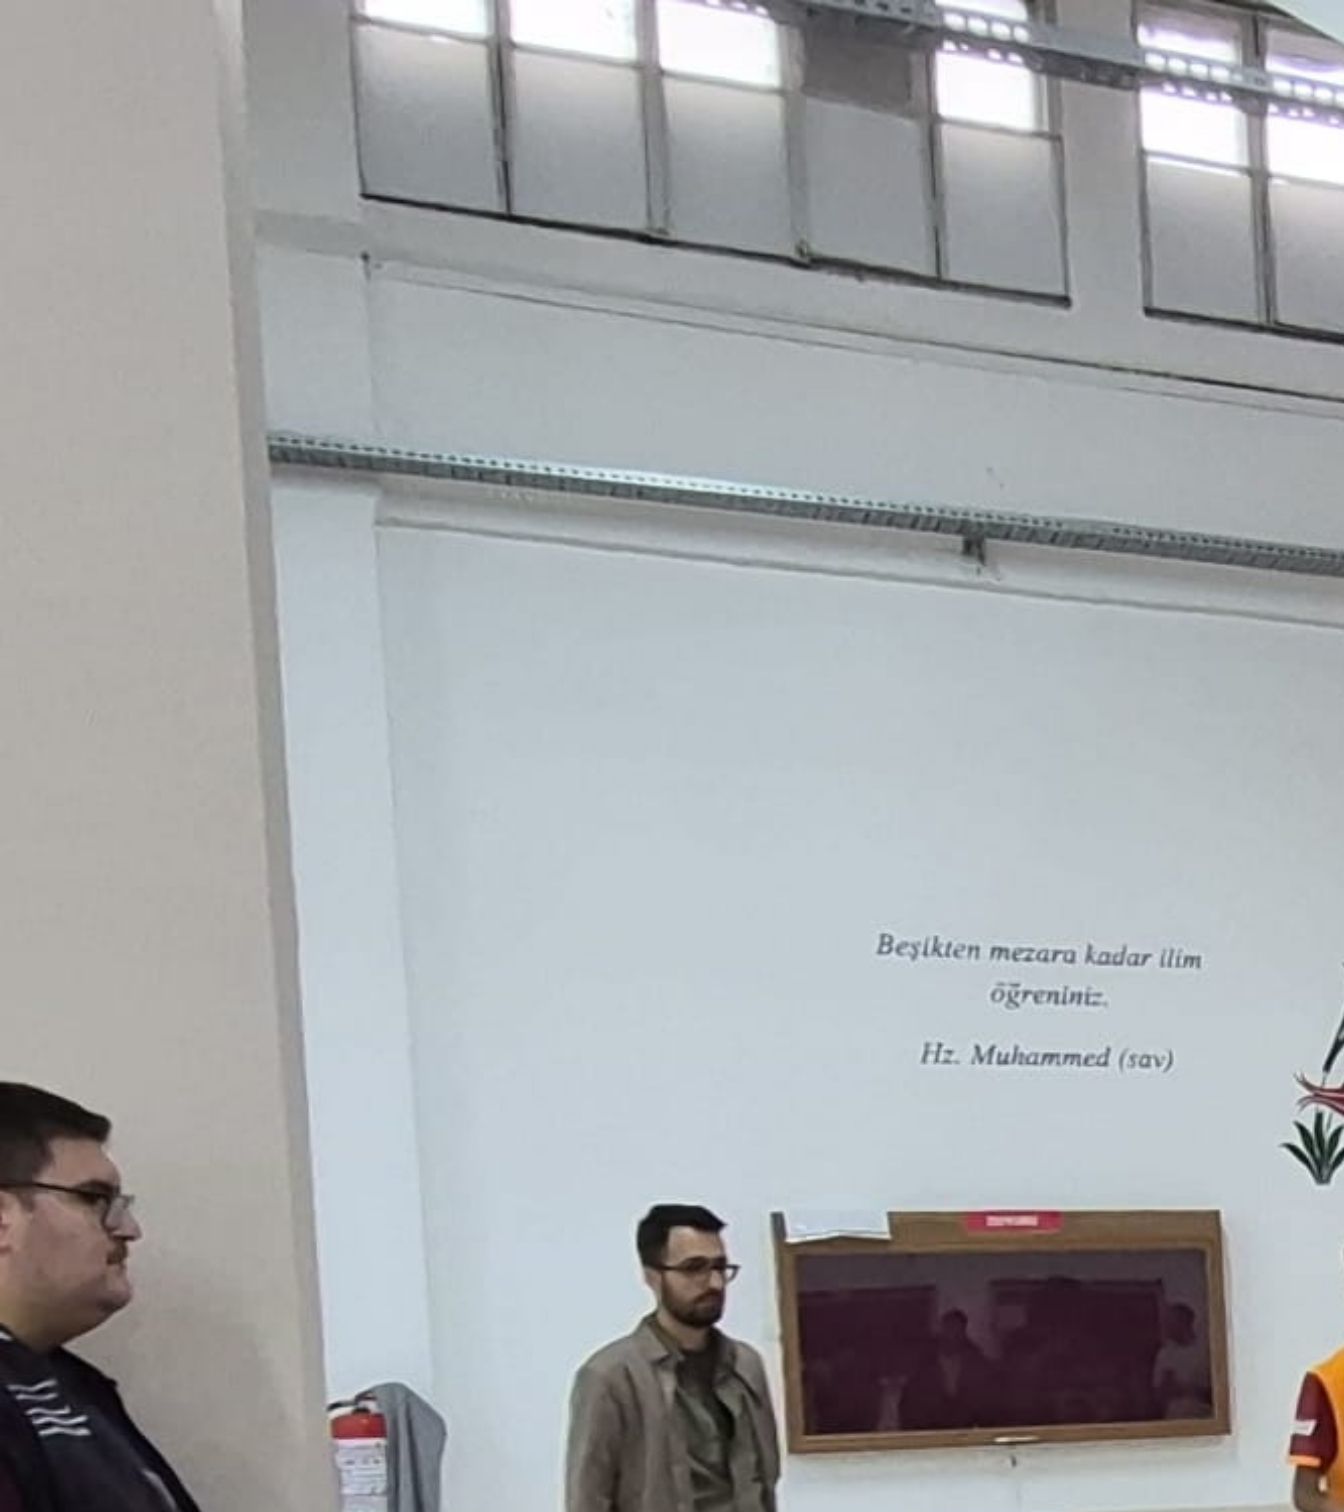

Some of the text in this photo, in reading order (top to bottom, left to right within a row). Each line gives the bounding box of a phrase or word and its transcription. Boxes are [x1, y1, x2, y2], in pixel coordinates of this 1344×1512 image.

[876, 933, 1202, 969] Beşikten mezara kadar ilim
[990, 982, 1108, 1010] öğreniniz.
[921, 1042, 1174, 1073] Hz. Muhammed (sav)
